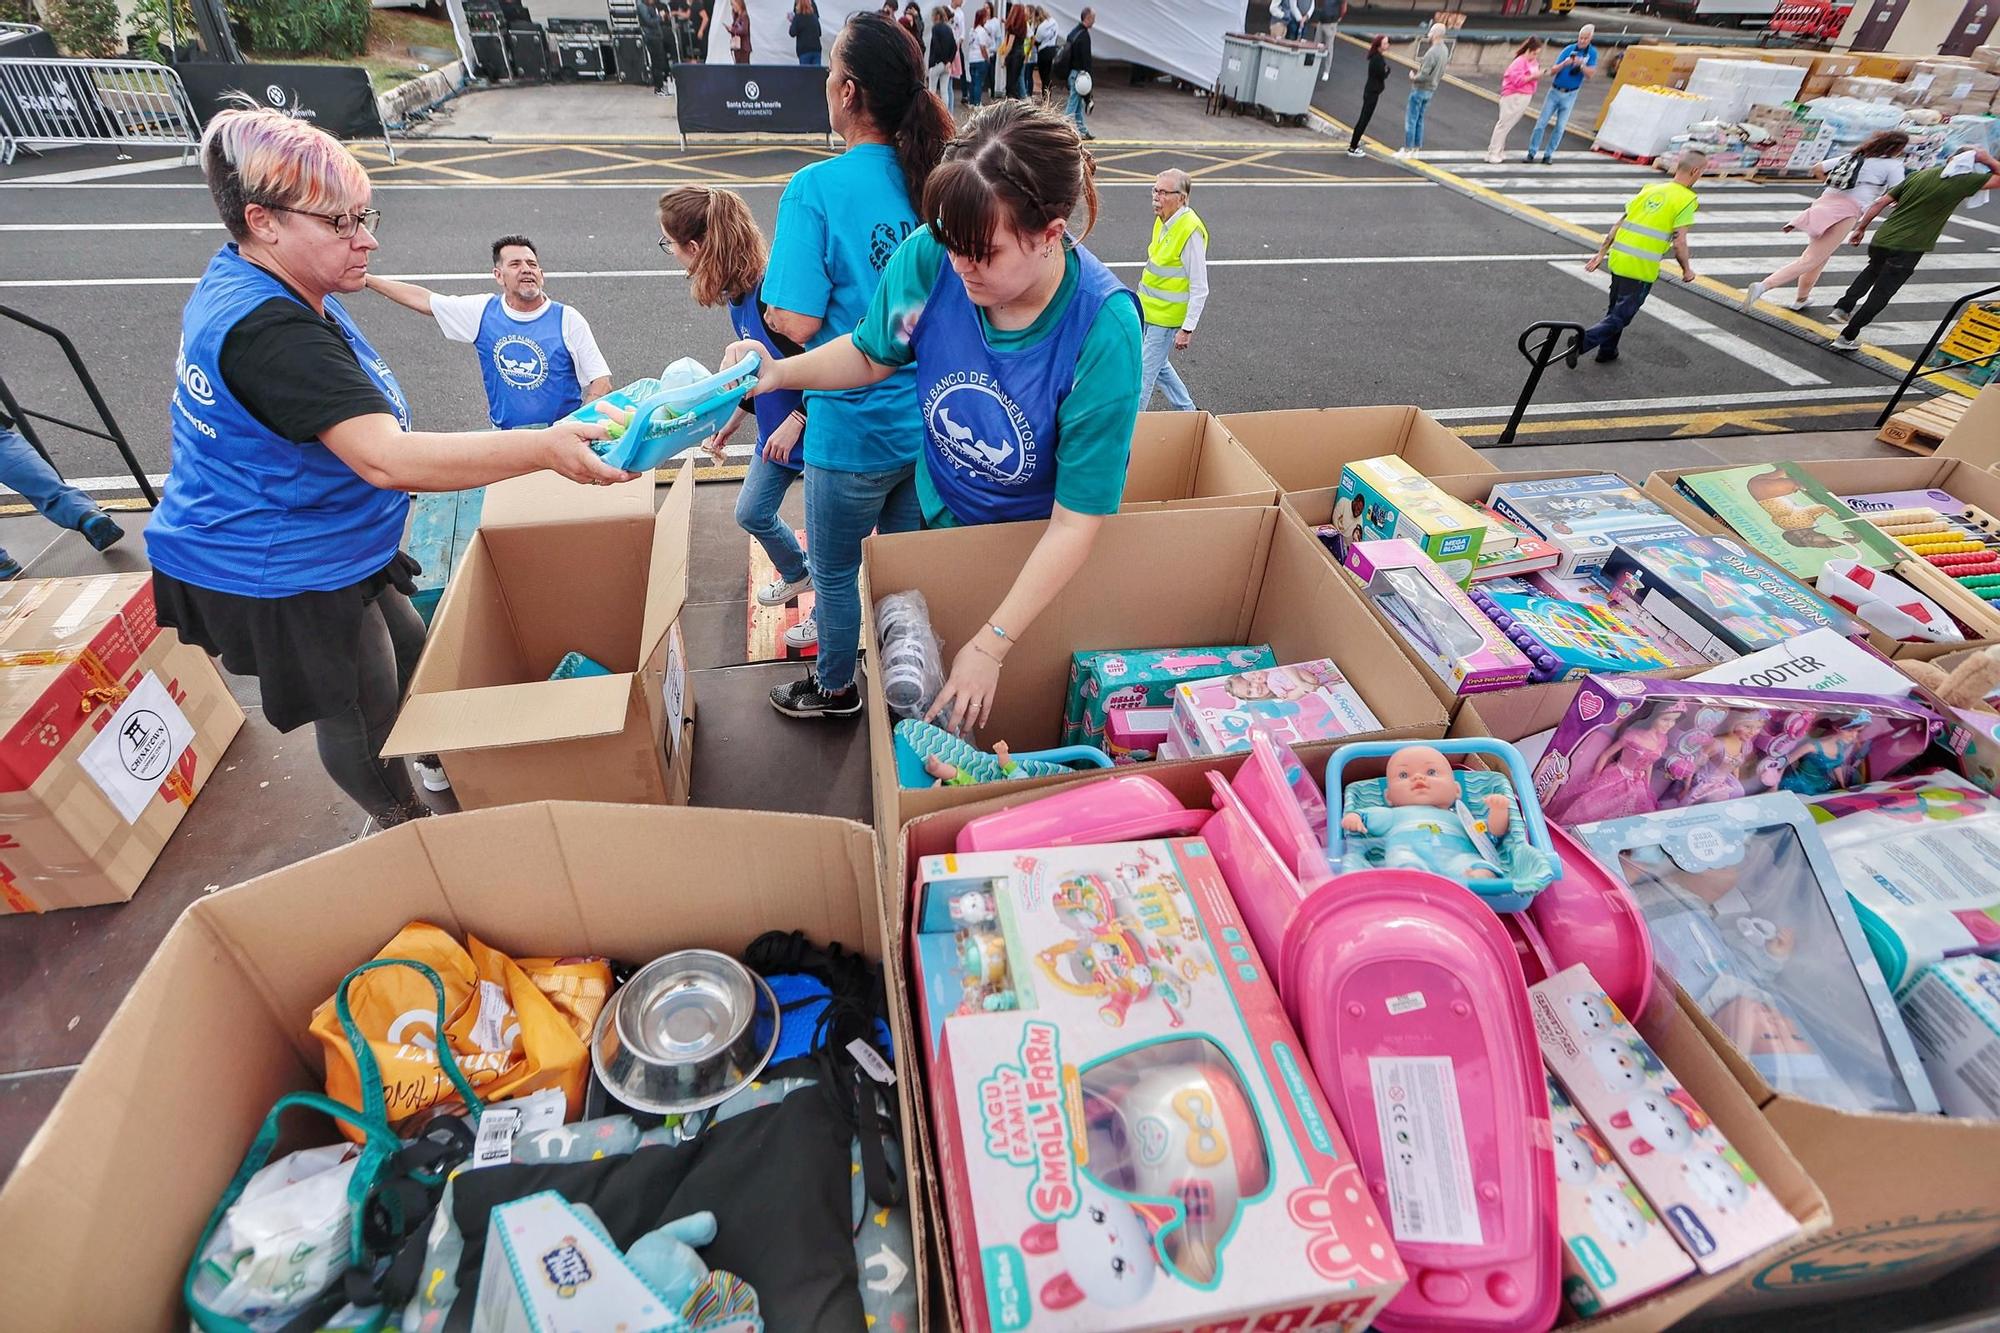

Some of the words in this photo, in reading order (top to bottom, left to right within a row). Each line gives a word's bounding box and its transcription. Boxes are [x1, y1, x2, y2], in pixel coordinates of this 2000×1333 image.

[742, 101, 753, 109] Cruz
[754, 101, 761, 109] de
[761, 101, 782, 109] Tenerife
[930, 371, 967, 398] BANCO
[970, 371, 989, 385] DE
[990, 380, 1036, 451] ALIMENTOS
[1024, 453, 1037, 470] DE
[1442, 544, 1466, 553] BLOKS
[1444, 537, 1467, 548] MEGA
[1722, 555, 1761, 579] SAND
[1759, 581, 1833, 626] CREATIONS
[1111, 694, 1144, 704] HELLO
[1739, 655, 1826, 688] COOTER
[131, 725, 165, 772] CHINATOWN
[1024, 1028, 1061, 1104] FARM
[987, 1085, 1010, 1149] LAGU
[1003, 1072, 1030, 1157] FAMILY
[1034, 1103, 1072, 1213] SMALL
